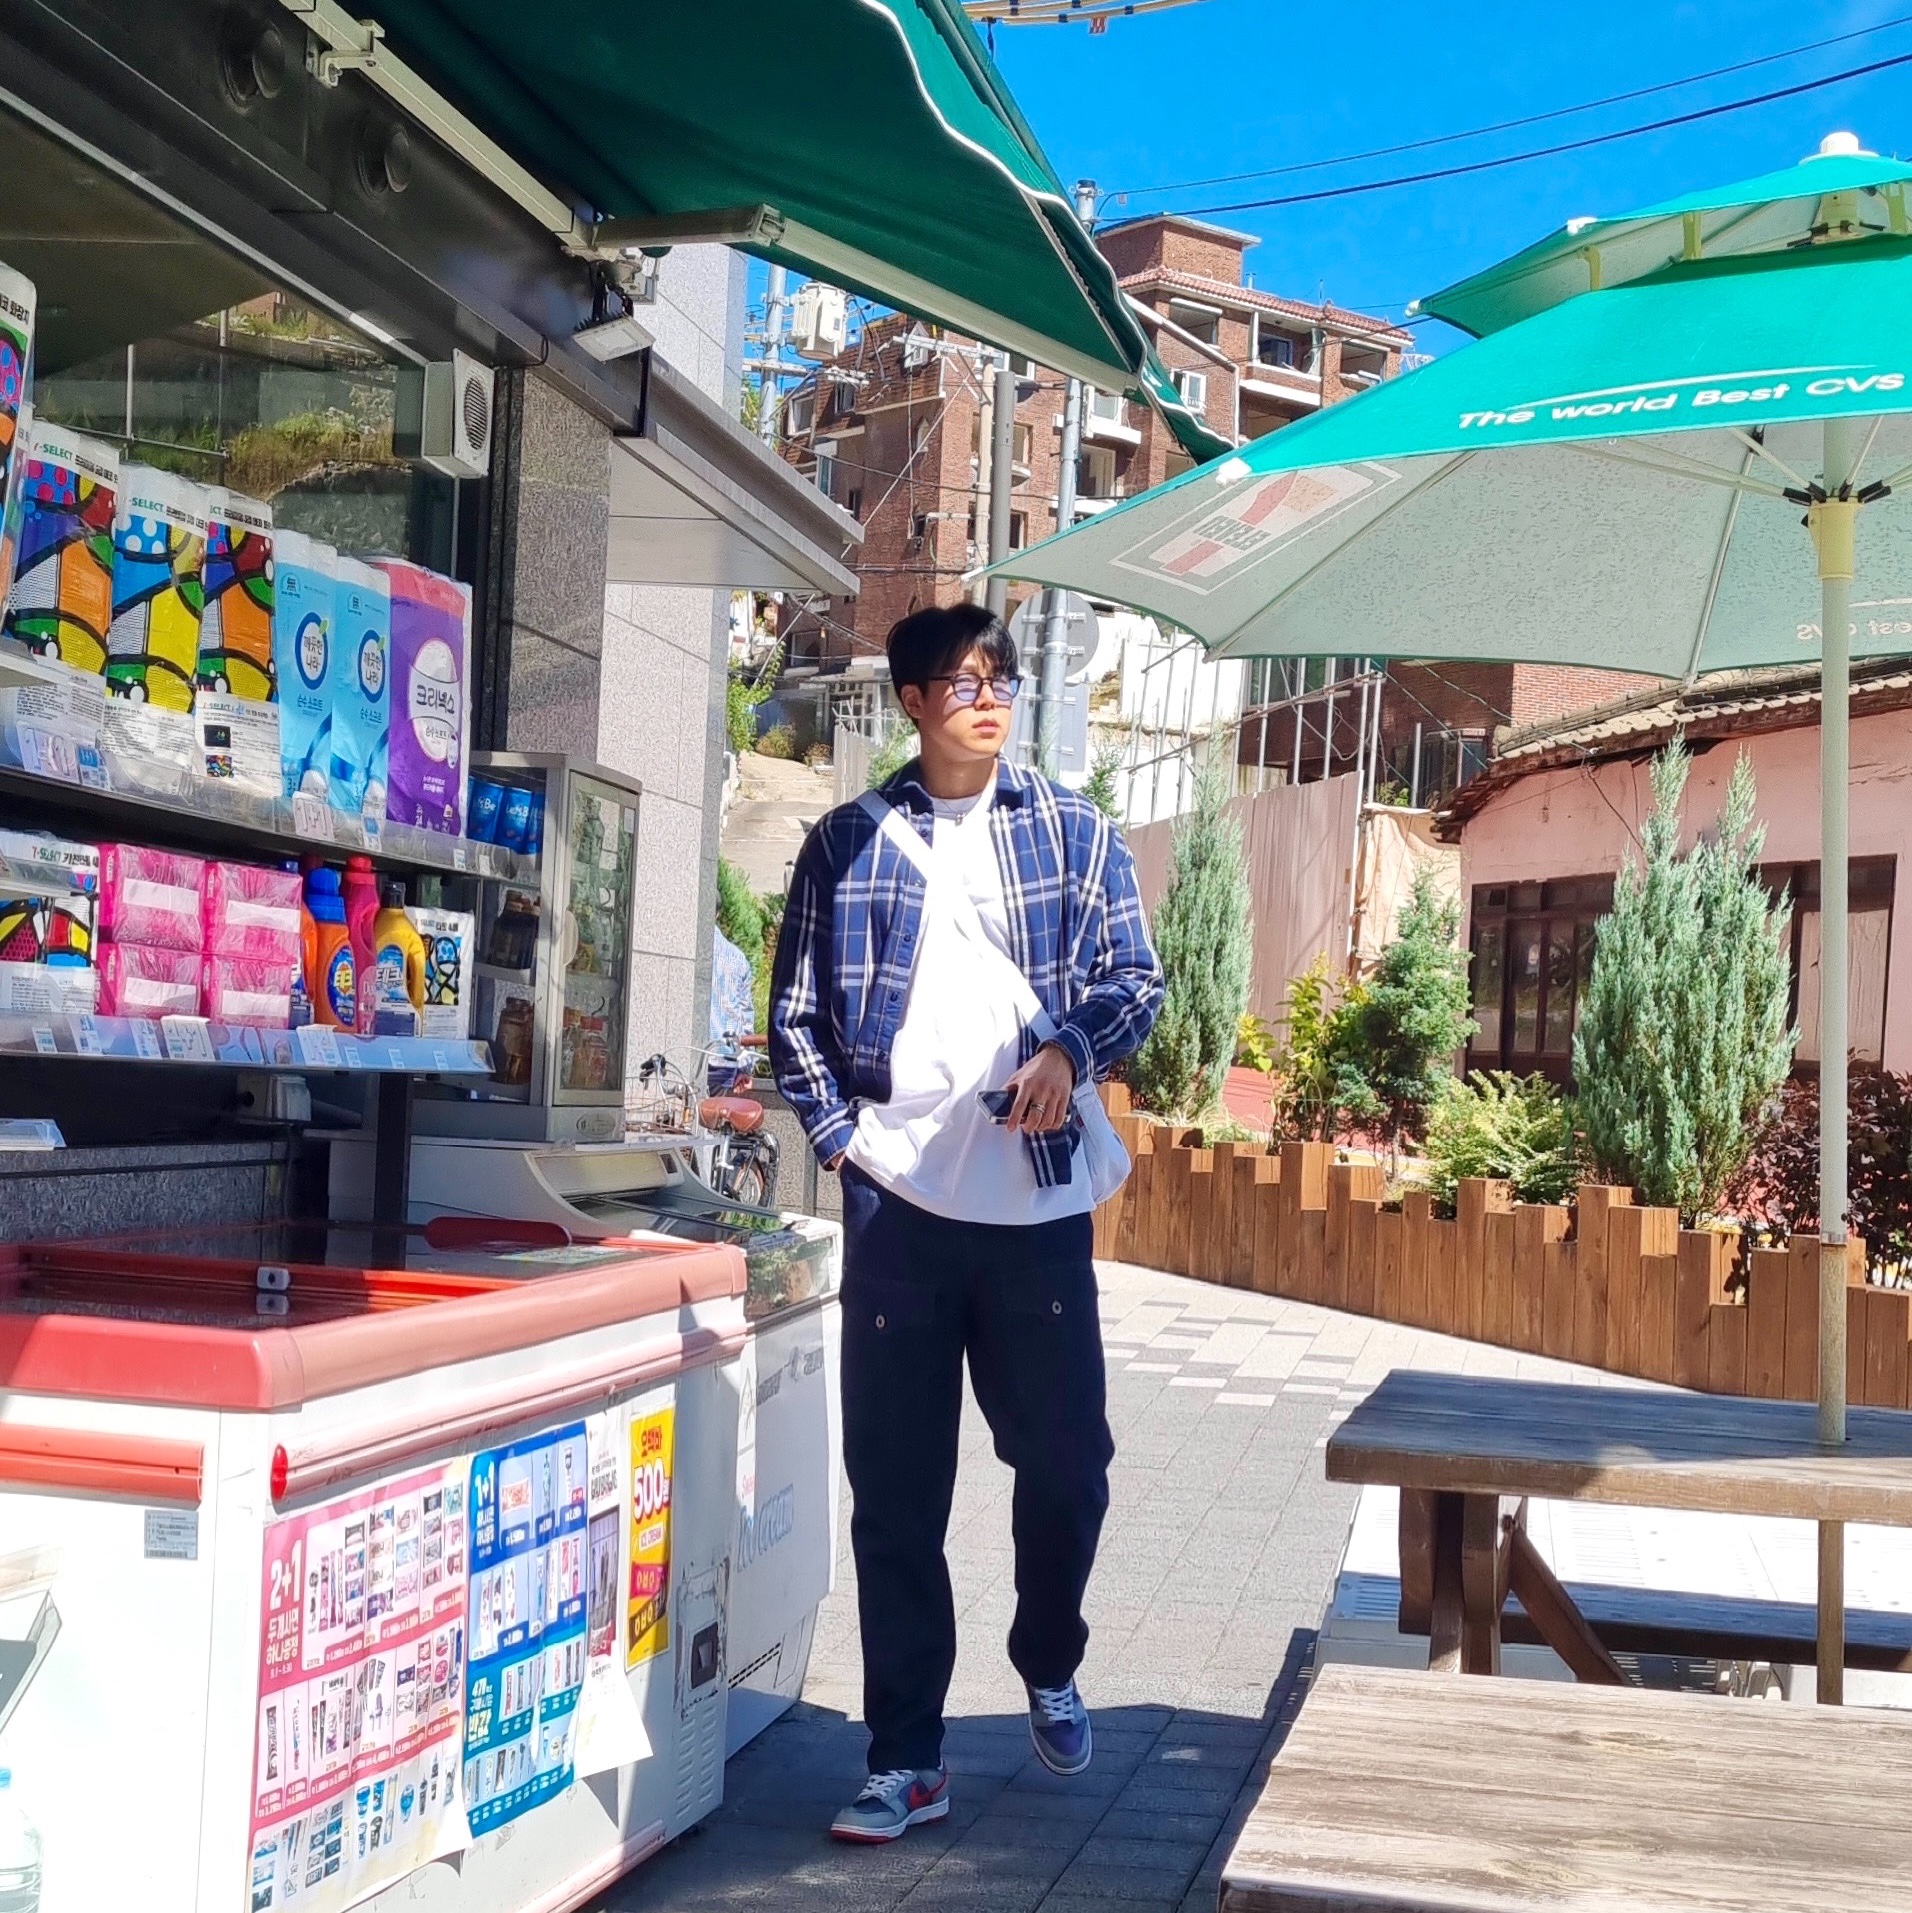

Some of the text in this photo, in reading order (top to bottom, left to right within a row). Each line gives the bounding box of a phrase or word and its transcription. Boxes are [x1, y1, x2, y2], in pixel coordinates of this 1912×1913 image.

[1458, 373, 1906, 429] The world Best CVS
[305, 654, 319, 673] 나라
[416, 684, 455, 715] 크리넥스
[474, 1460, 495, 1507] 1+1
[269, 1539, 303, 1612] 2+1
